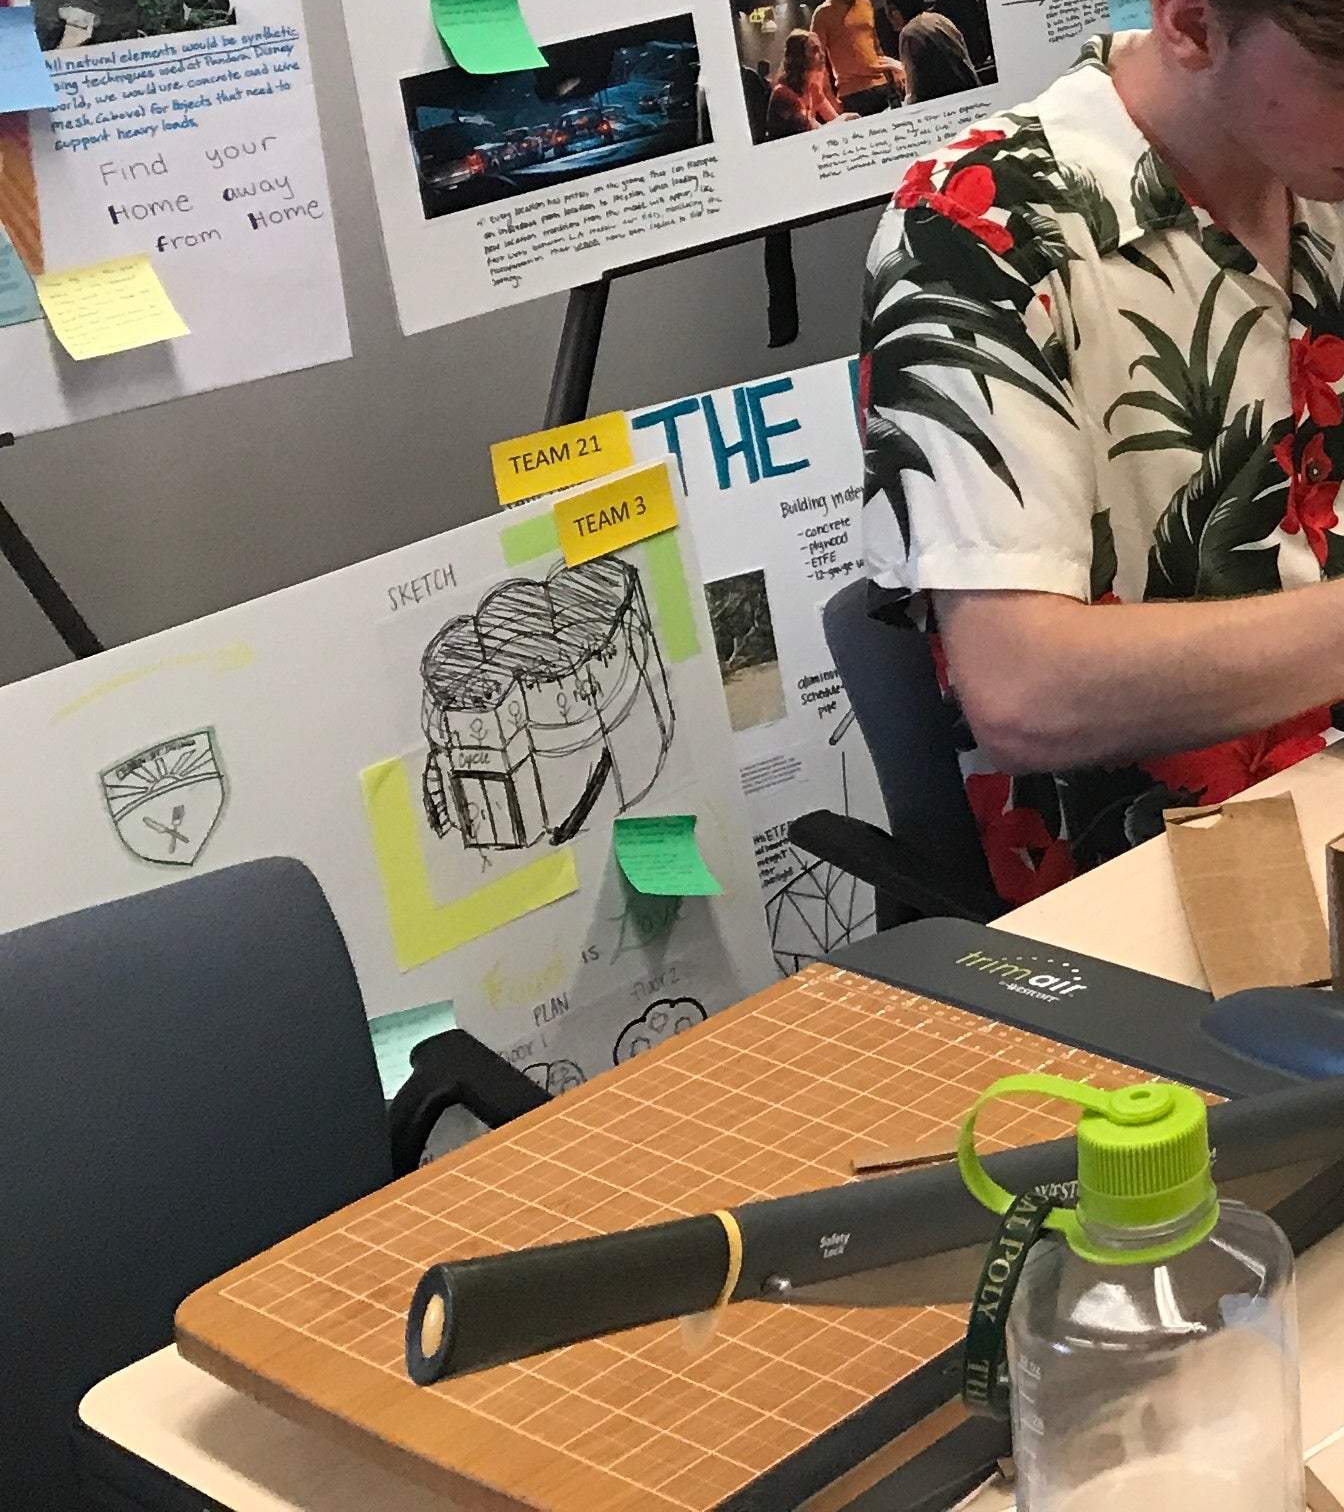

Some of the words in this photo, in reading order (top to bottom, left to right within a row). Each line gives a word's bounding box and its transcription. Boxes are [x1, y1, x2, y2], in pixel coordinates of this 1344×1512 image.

[99, 152, 170, 186] Find
[204, 136, 279, 170] your
[107, 192, 196, 225] Home
[155, 226, 223, 253] from
[247, 198, 326, 231] Home
[508, 441, 574, 475] TEAM
[576, 433, 603, 458] 21
[631, 376, 811, 496] THE
[572, 500, 631, 538] TEAM
[634, 495, 648, 519] 3
[779, 491, 830, 519] Building
[386, 563, 460, 613] SKETCH
[976, 1235, 1025, 1323] POLY
